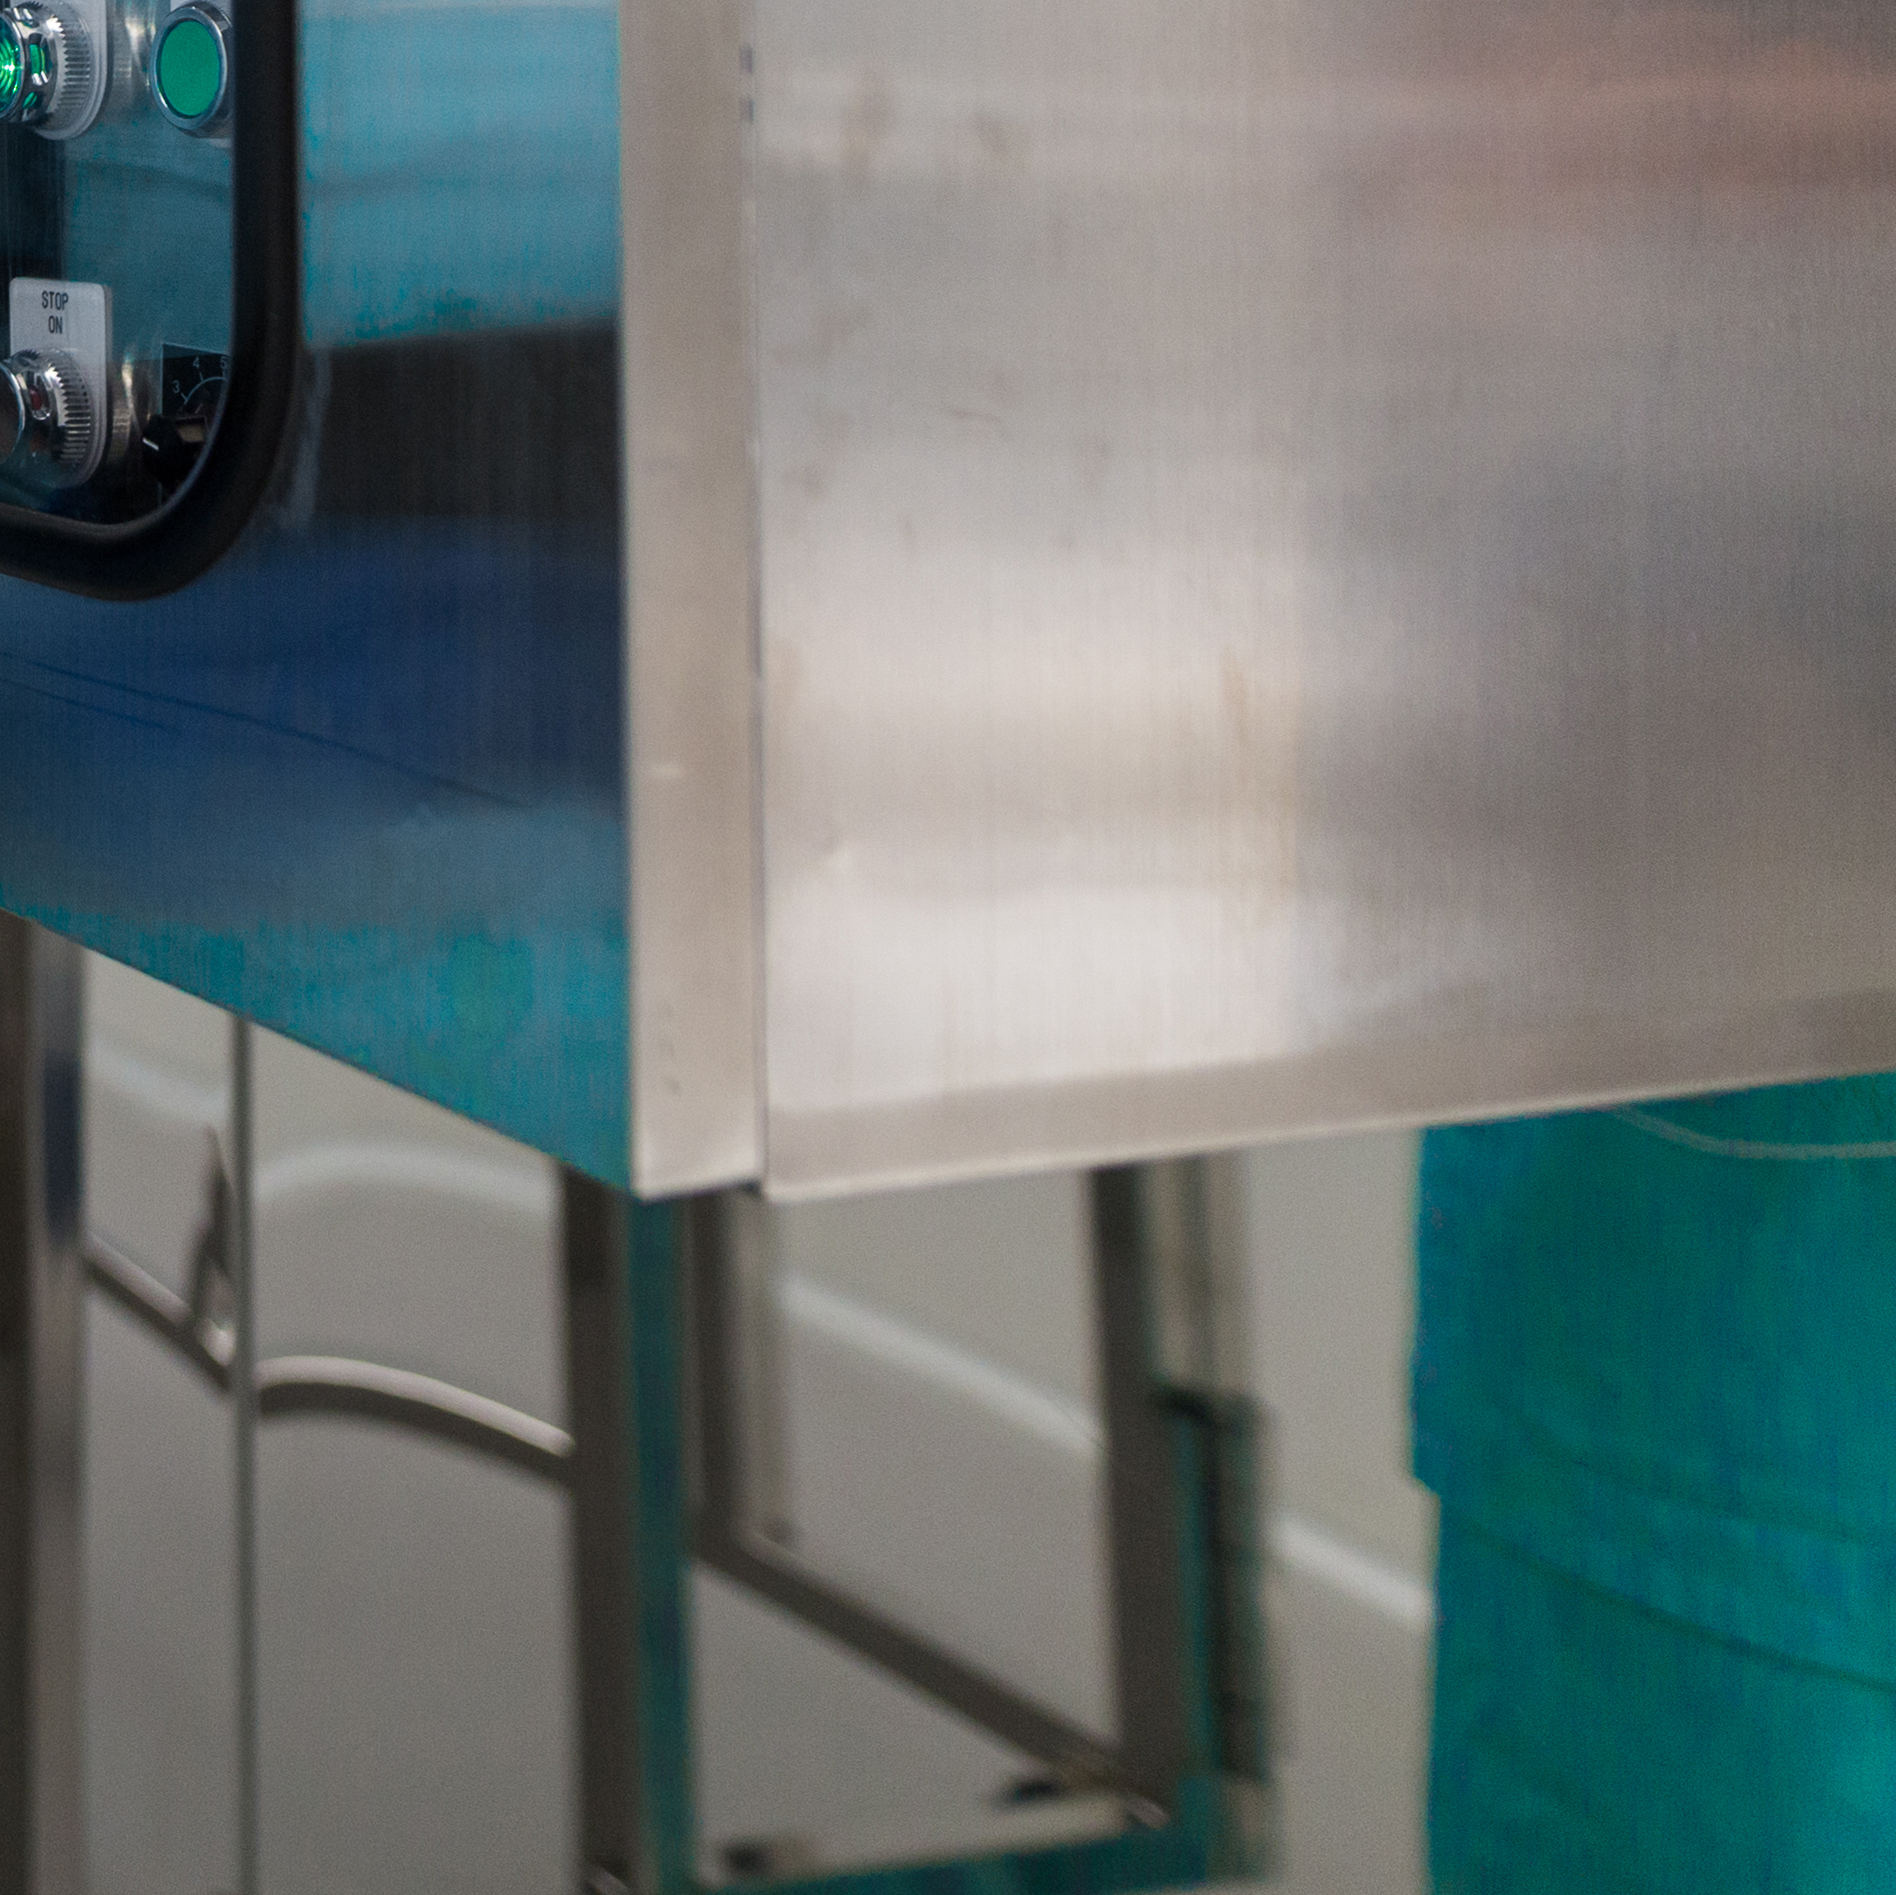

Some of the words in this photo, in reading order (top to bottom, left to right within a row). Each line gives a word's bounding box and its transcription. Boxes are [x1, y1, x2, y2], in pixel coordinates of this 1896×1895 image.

[41, 290, 69, 311] STOP
[47, 316, 63, 334] ON
[172, 379, 180, 394] 3
[192, 356, 200, 369] 4
